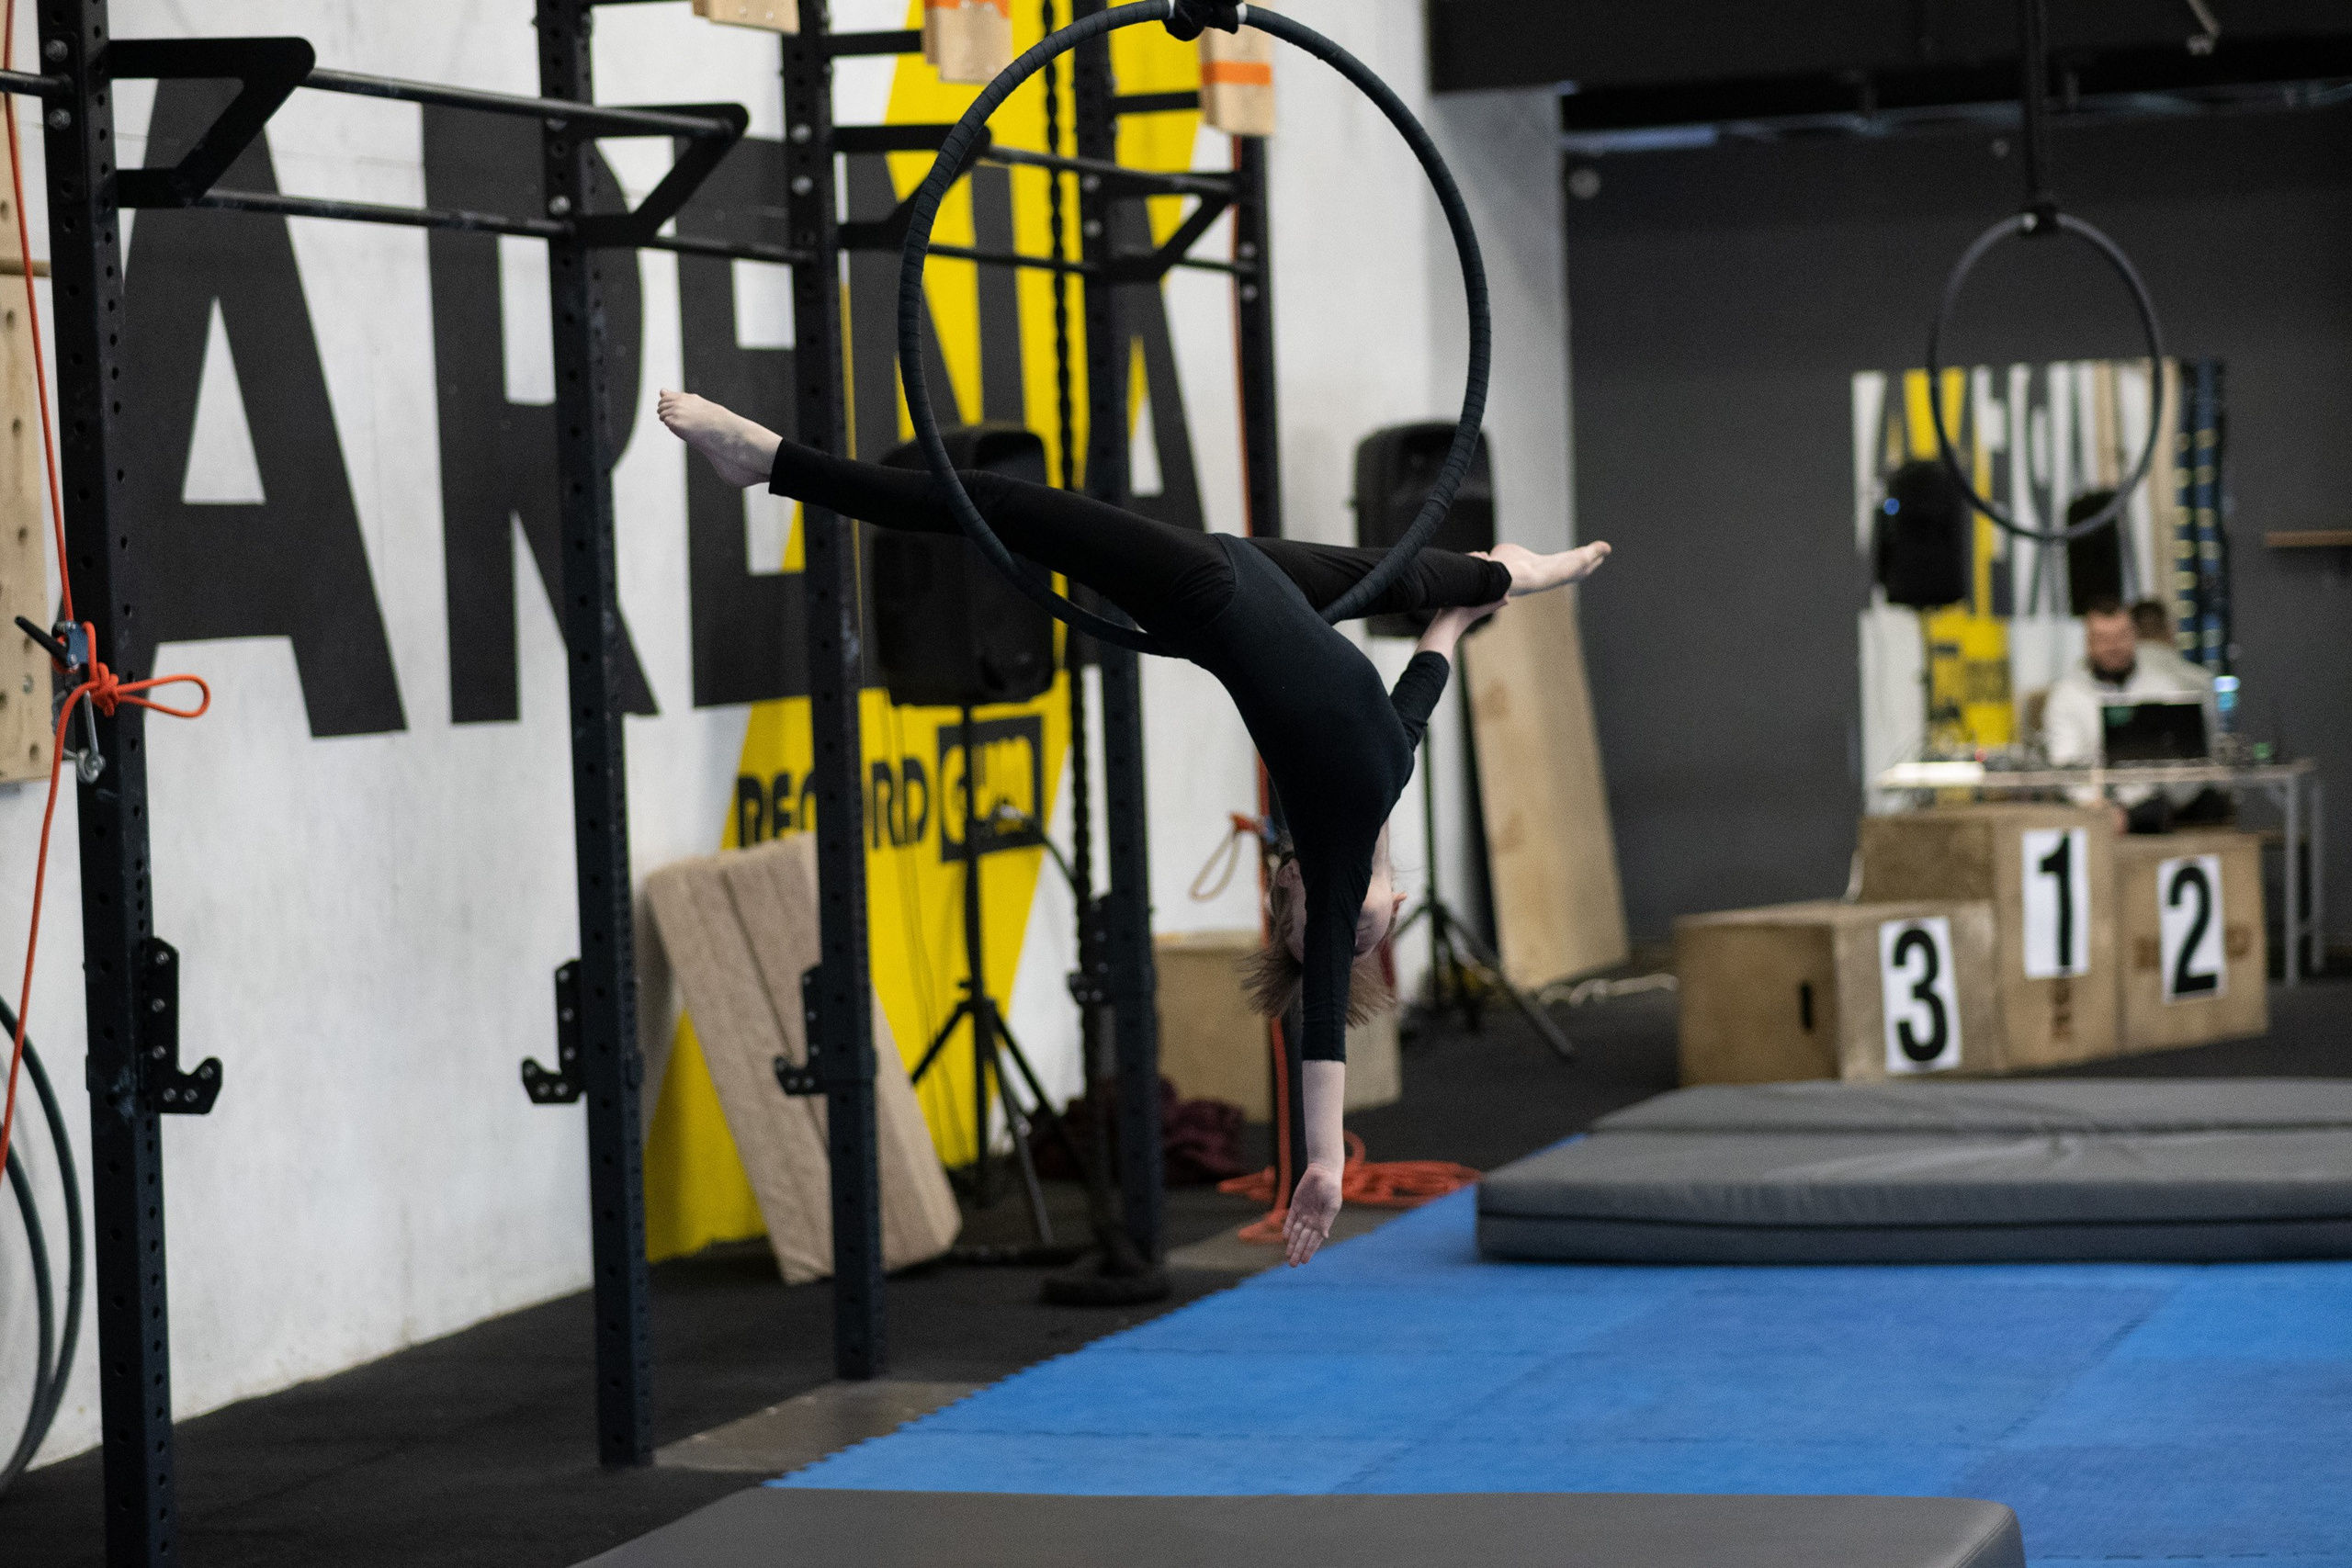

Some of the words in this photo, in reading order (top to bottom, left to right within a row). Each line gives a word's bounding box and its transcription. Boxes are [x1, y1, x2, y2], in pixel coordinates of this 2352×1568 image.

[739, 759, 928, 850] RERD
[2039, 832, 2073, 967] 1
[2168, 864, 2218, 994] 2
[1893, 928, 1949, 1062] 3
